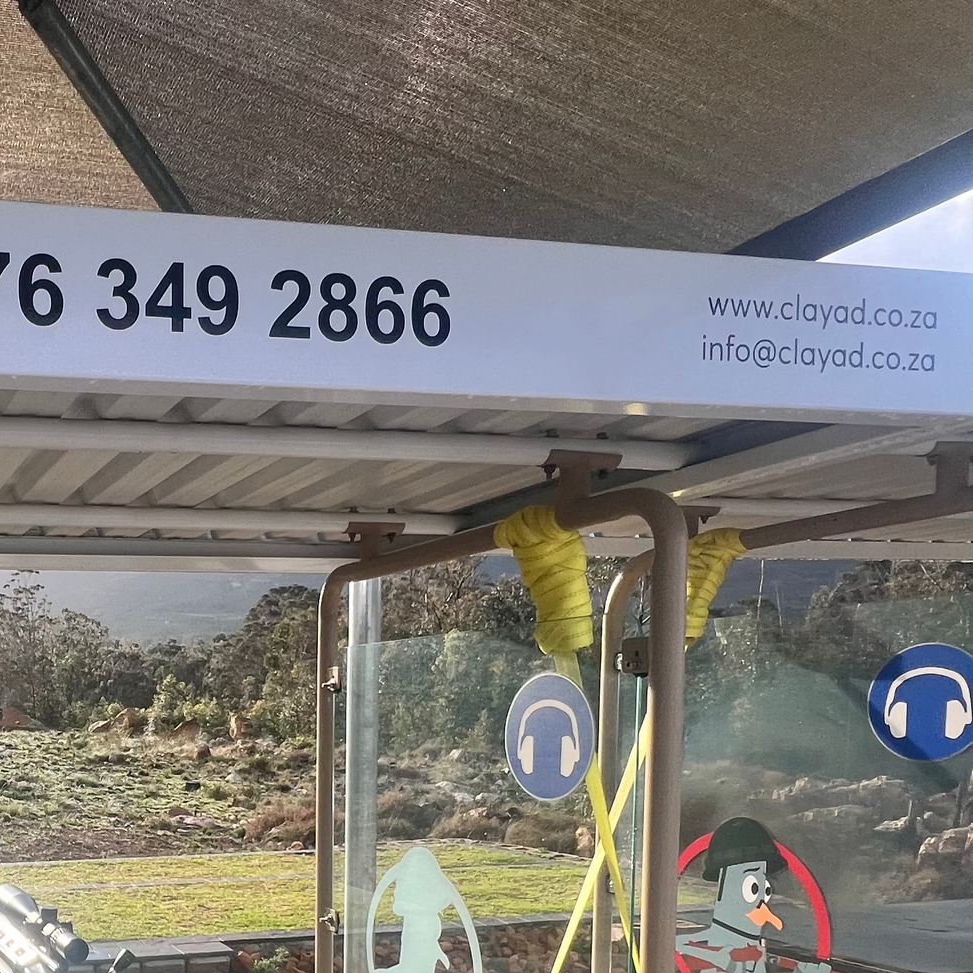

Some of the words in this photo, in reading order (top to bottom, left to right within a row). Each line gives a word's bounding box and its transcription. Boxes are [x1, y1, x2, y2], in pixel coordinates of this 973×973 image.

[96, 258, 240, 336] 349
[268, 269, 452, 347] 2866
[708, 293, 938, 330] www.clayad.co.za
[701, 334, 936, 374] info@clayad.co.za
